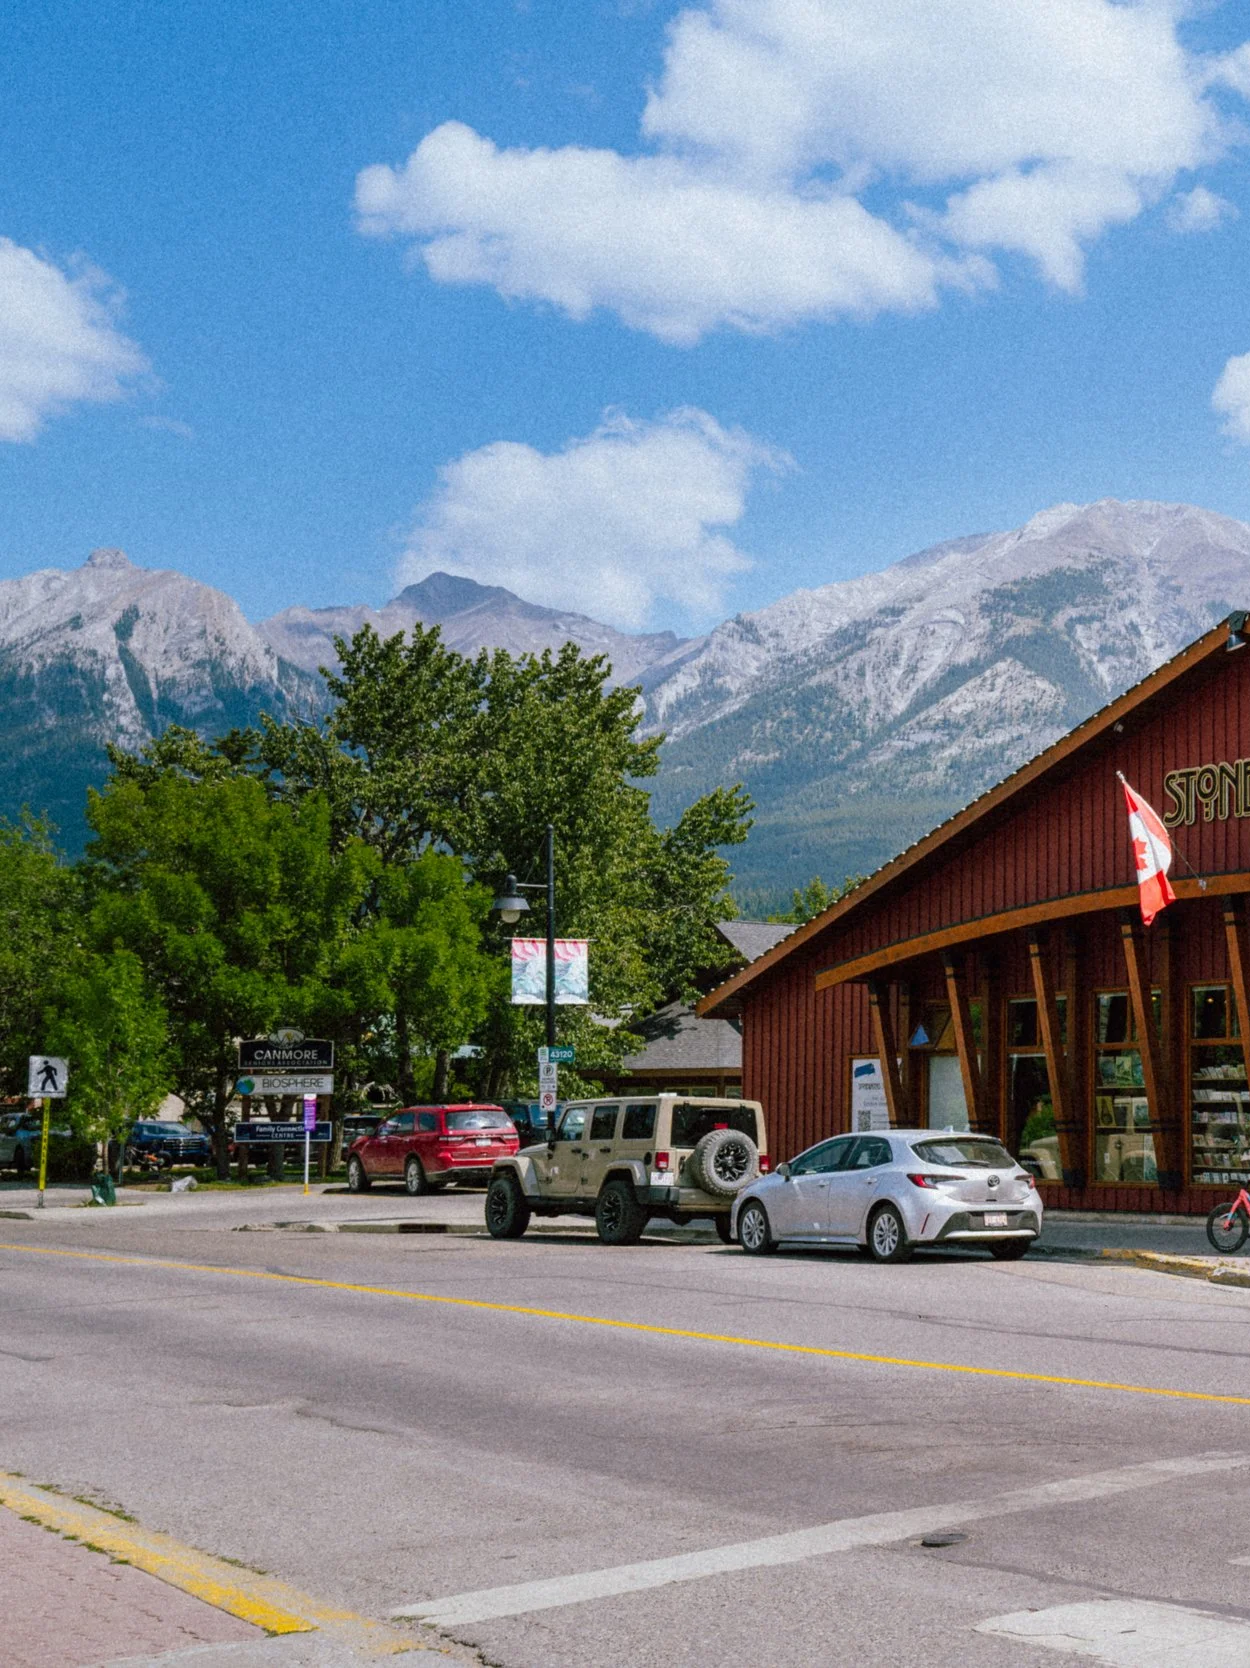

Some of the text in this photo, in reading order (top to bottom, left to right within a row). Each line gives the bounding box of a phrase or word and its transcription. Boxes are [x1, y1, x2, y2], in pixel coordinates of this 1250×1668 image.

[254, 1049, 319, 1060] CANMORE
[550, 1050, 573, 1059] 43120
[262, 1077, 324, 1089] BIOSPHERE
[255, 1125, 276, 1133] Family
